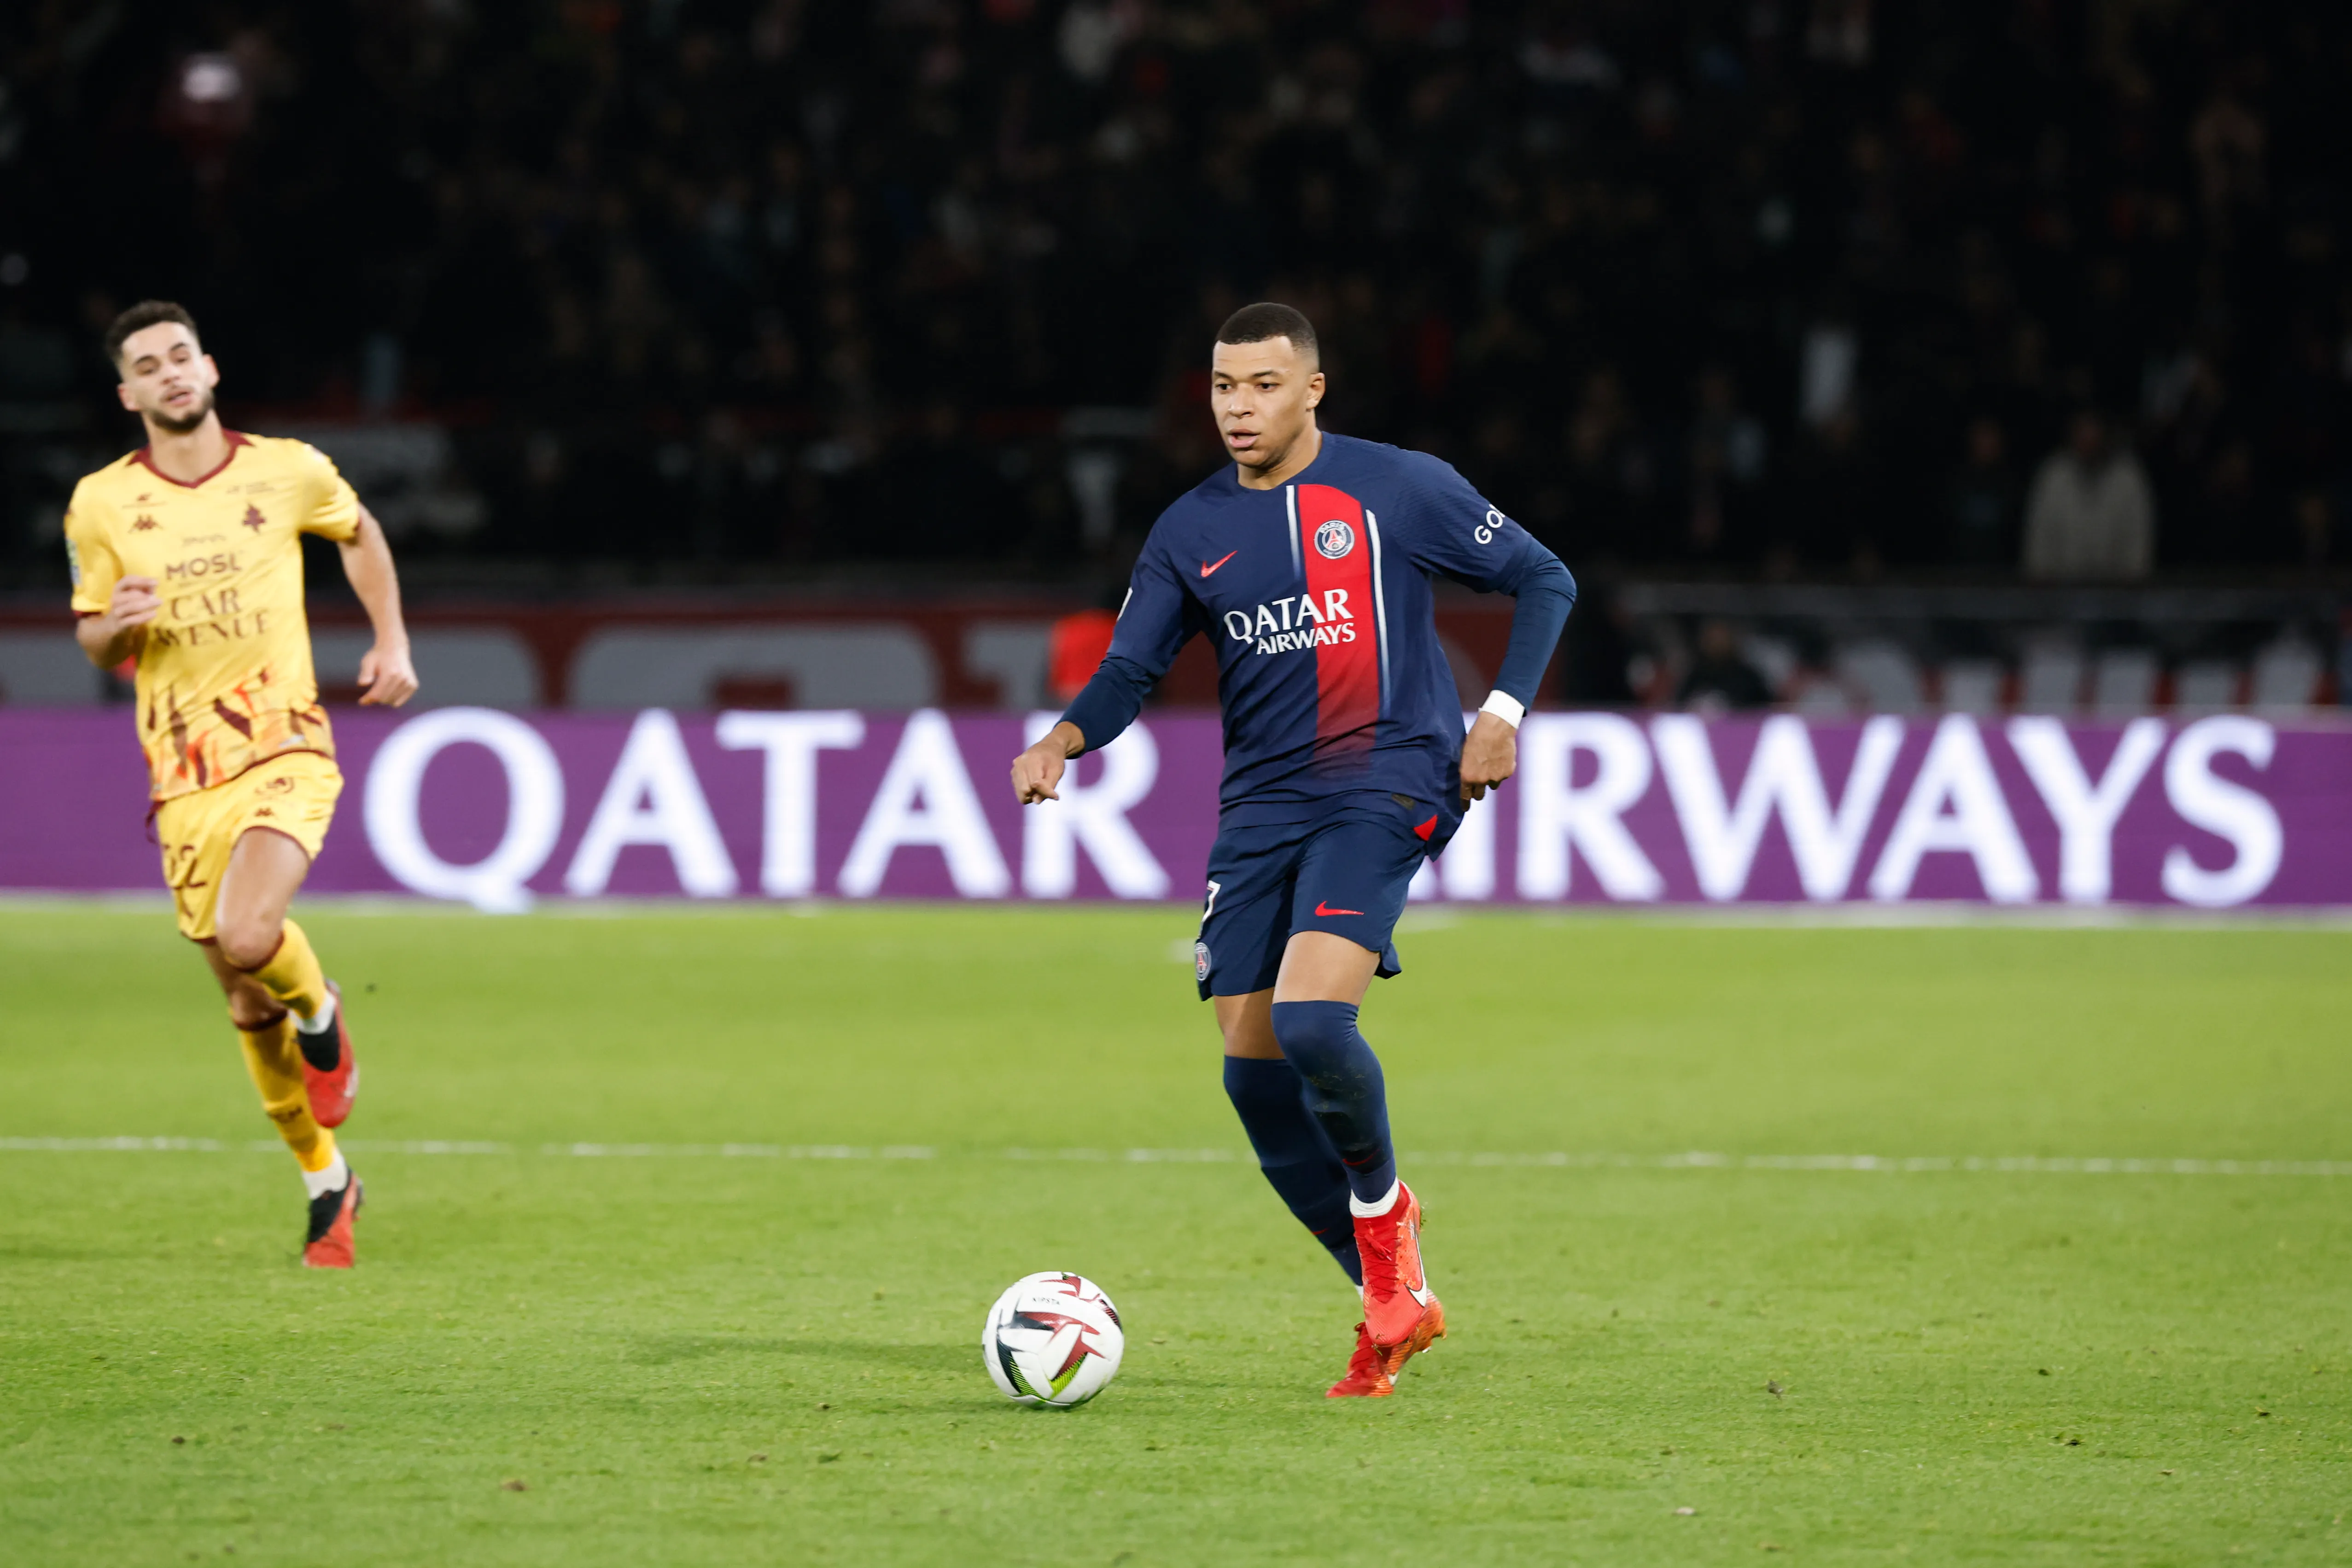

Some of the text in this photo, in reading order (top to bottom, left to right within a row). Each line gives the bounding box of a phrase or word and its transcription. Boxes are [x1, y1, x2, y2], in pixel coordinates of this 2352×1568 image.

[1474, 504, 1506, 544] GO
[166, 552, 242, 580] MOSL
[171, 587, 242, 620] CAR
[1223, 589, 1354, 644] QATAR
[1256, 622, 1356, 654] AIRWAYS
[363, 706, 2284, 915] QATAR IRWAYS
[1198, 880, 1221, 938] 7
